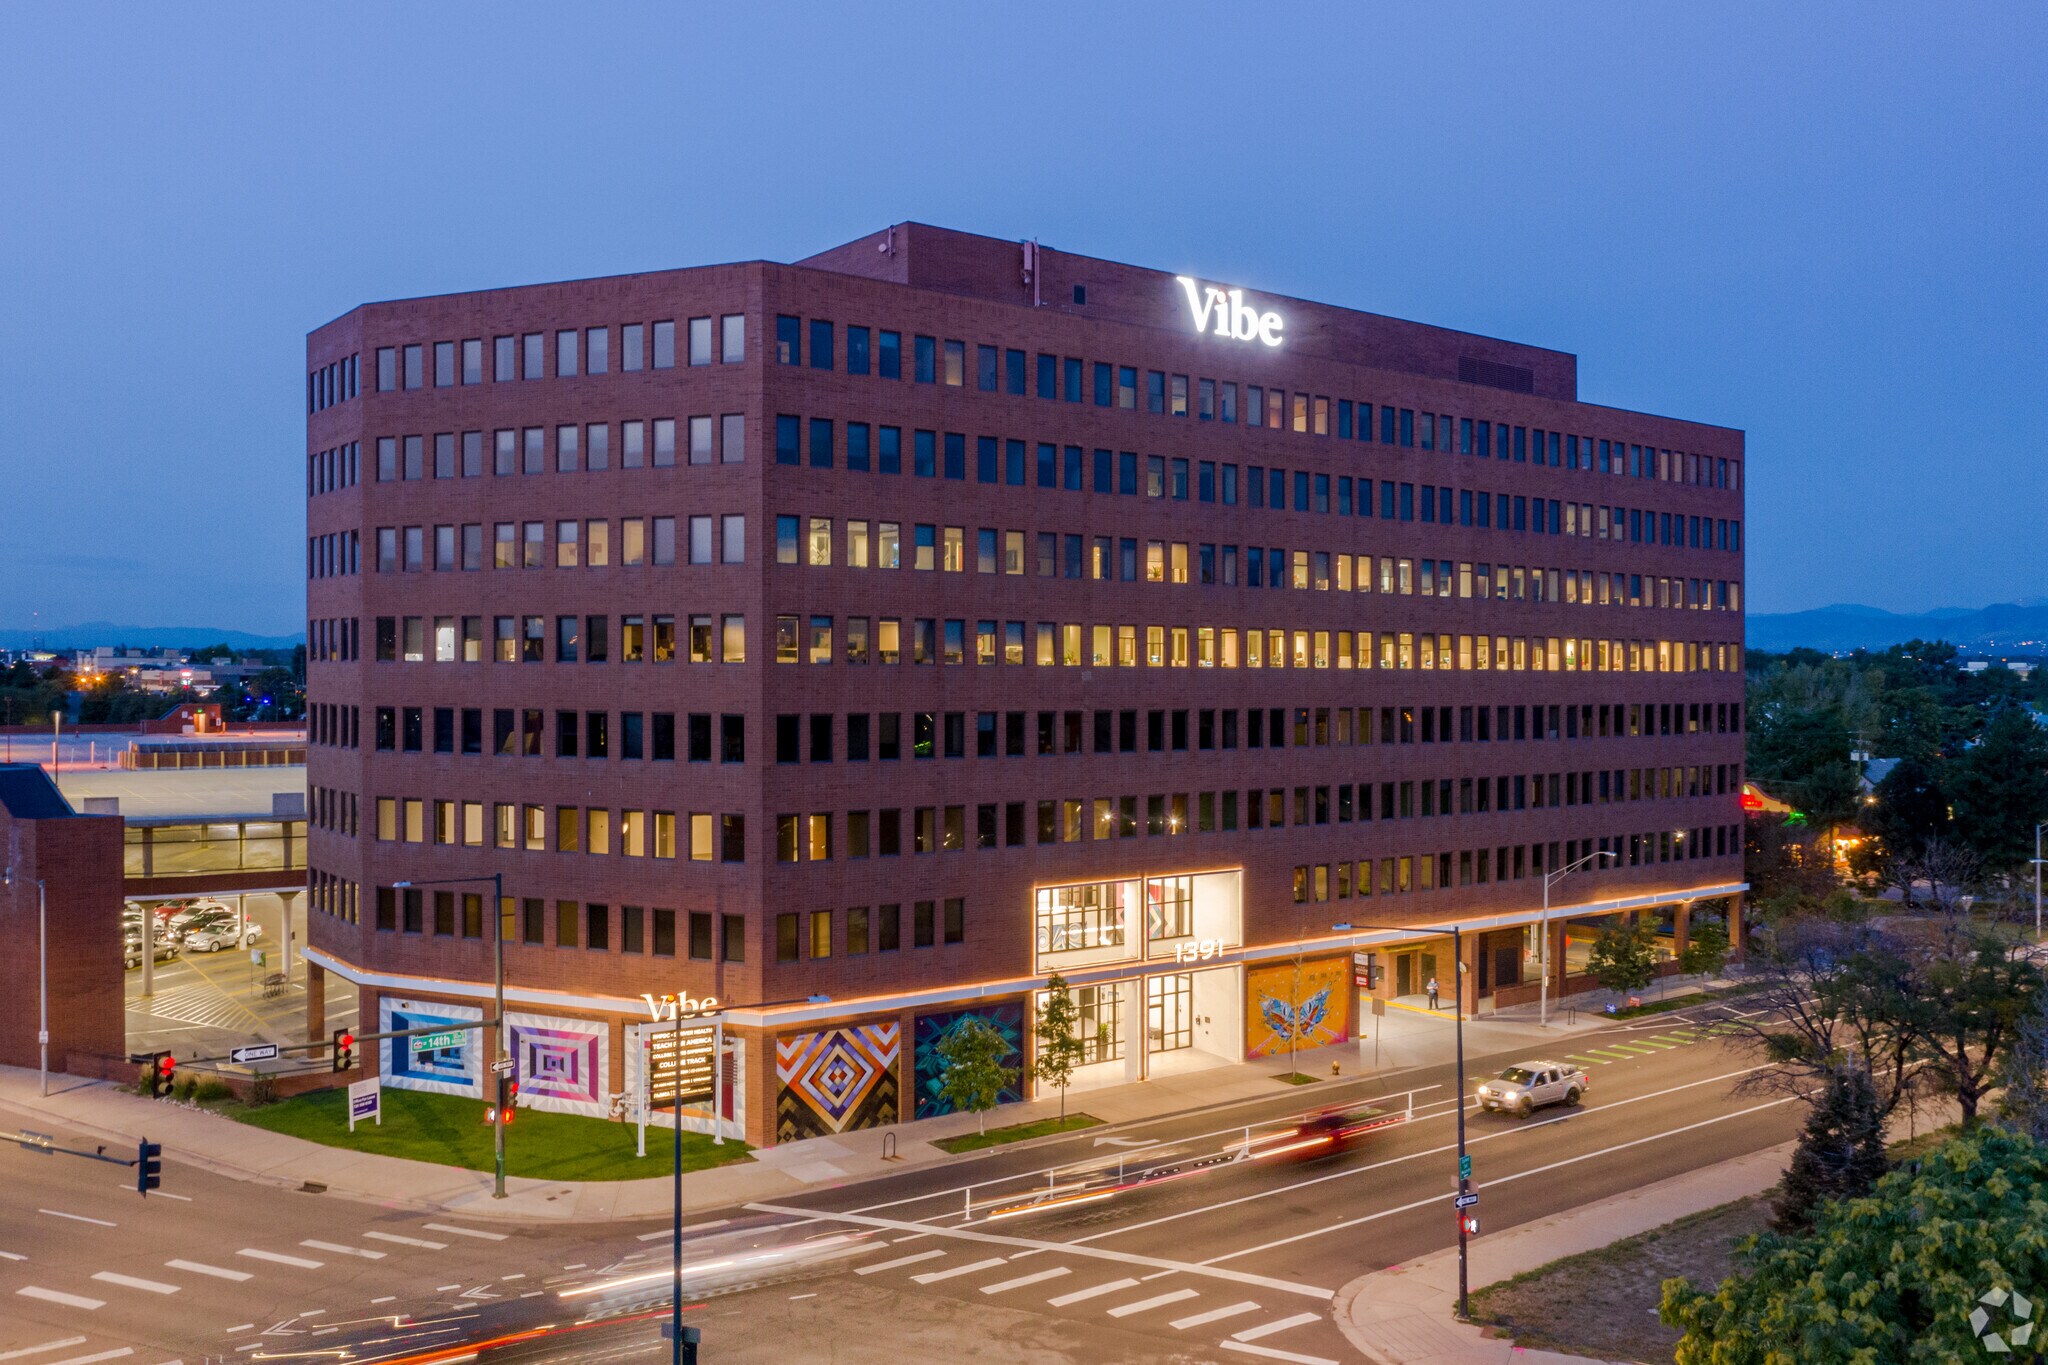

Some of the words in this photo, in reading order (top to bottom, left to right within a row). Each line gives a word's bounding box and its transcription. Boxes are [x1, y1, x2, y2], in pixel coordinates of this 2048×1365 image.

[1176, 276, 1283, 347] Vibe
[1174, 938, 1223, 963] 1391
[640, 990, 718, 1022] Vibe
[429, 1035, 450, 1048] 14th
[652, 1042, 672, 1050] TEACH
[673, 1040, 686, 1048] FR
[686, 1037, 712, 1046] AMERICA
[687, 1056, 706, 1065] TRACK
